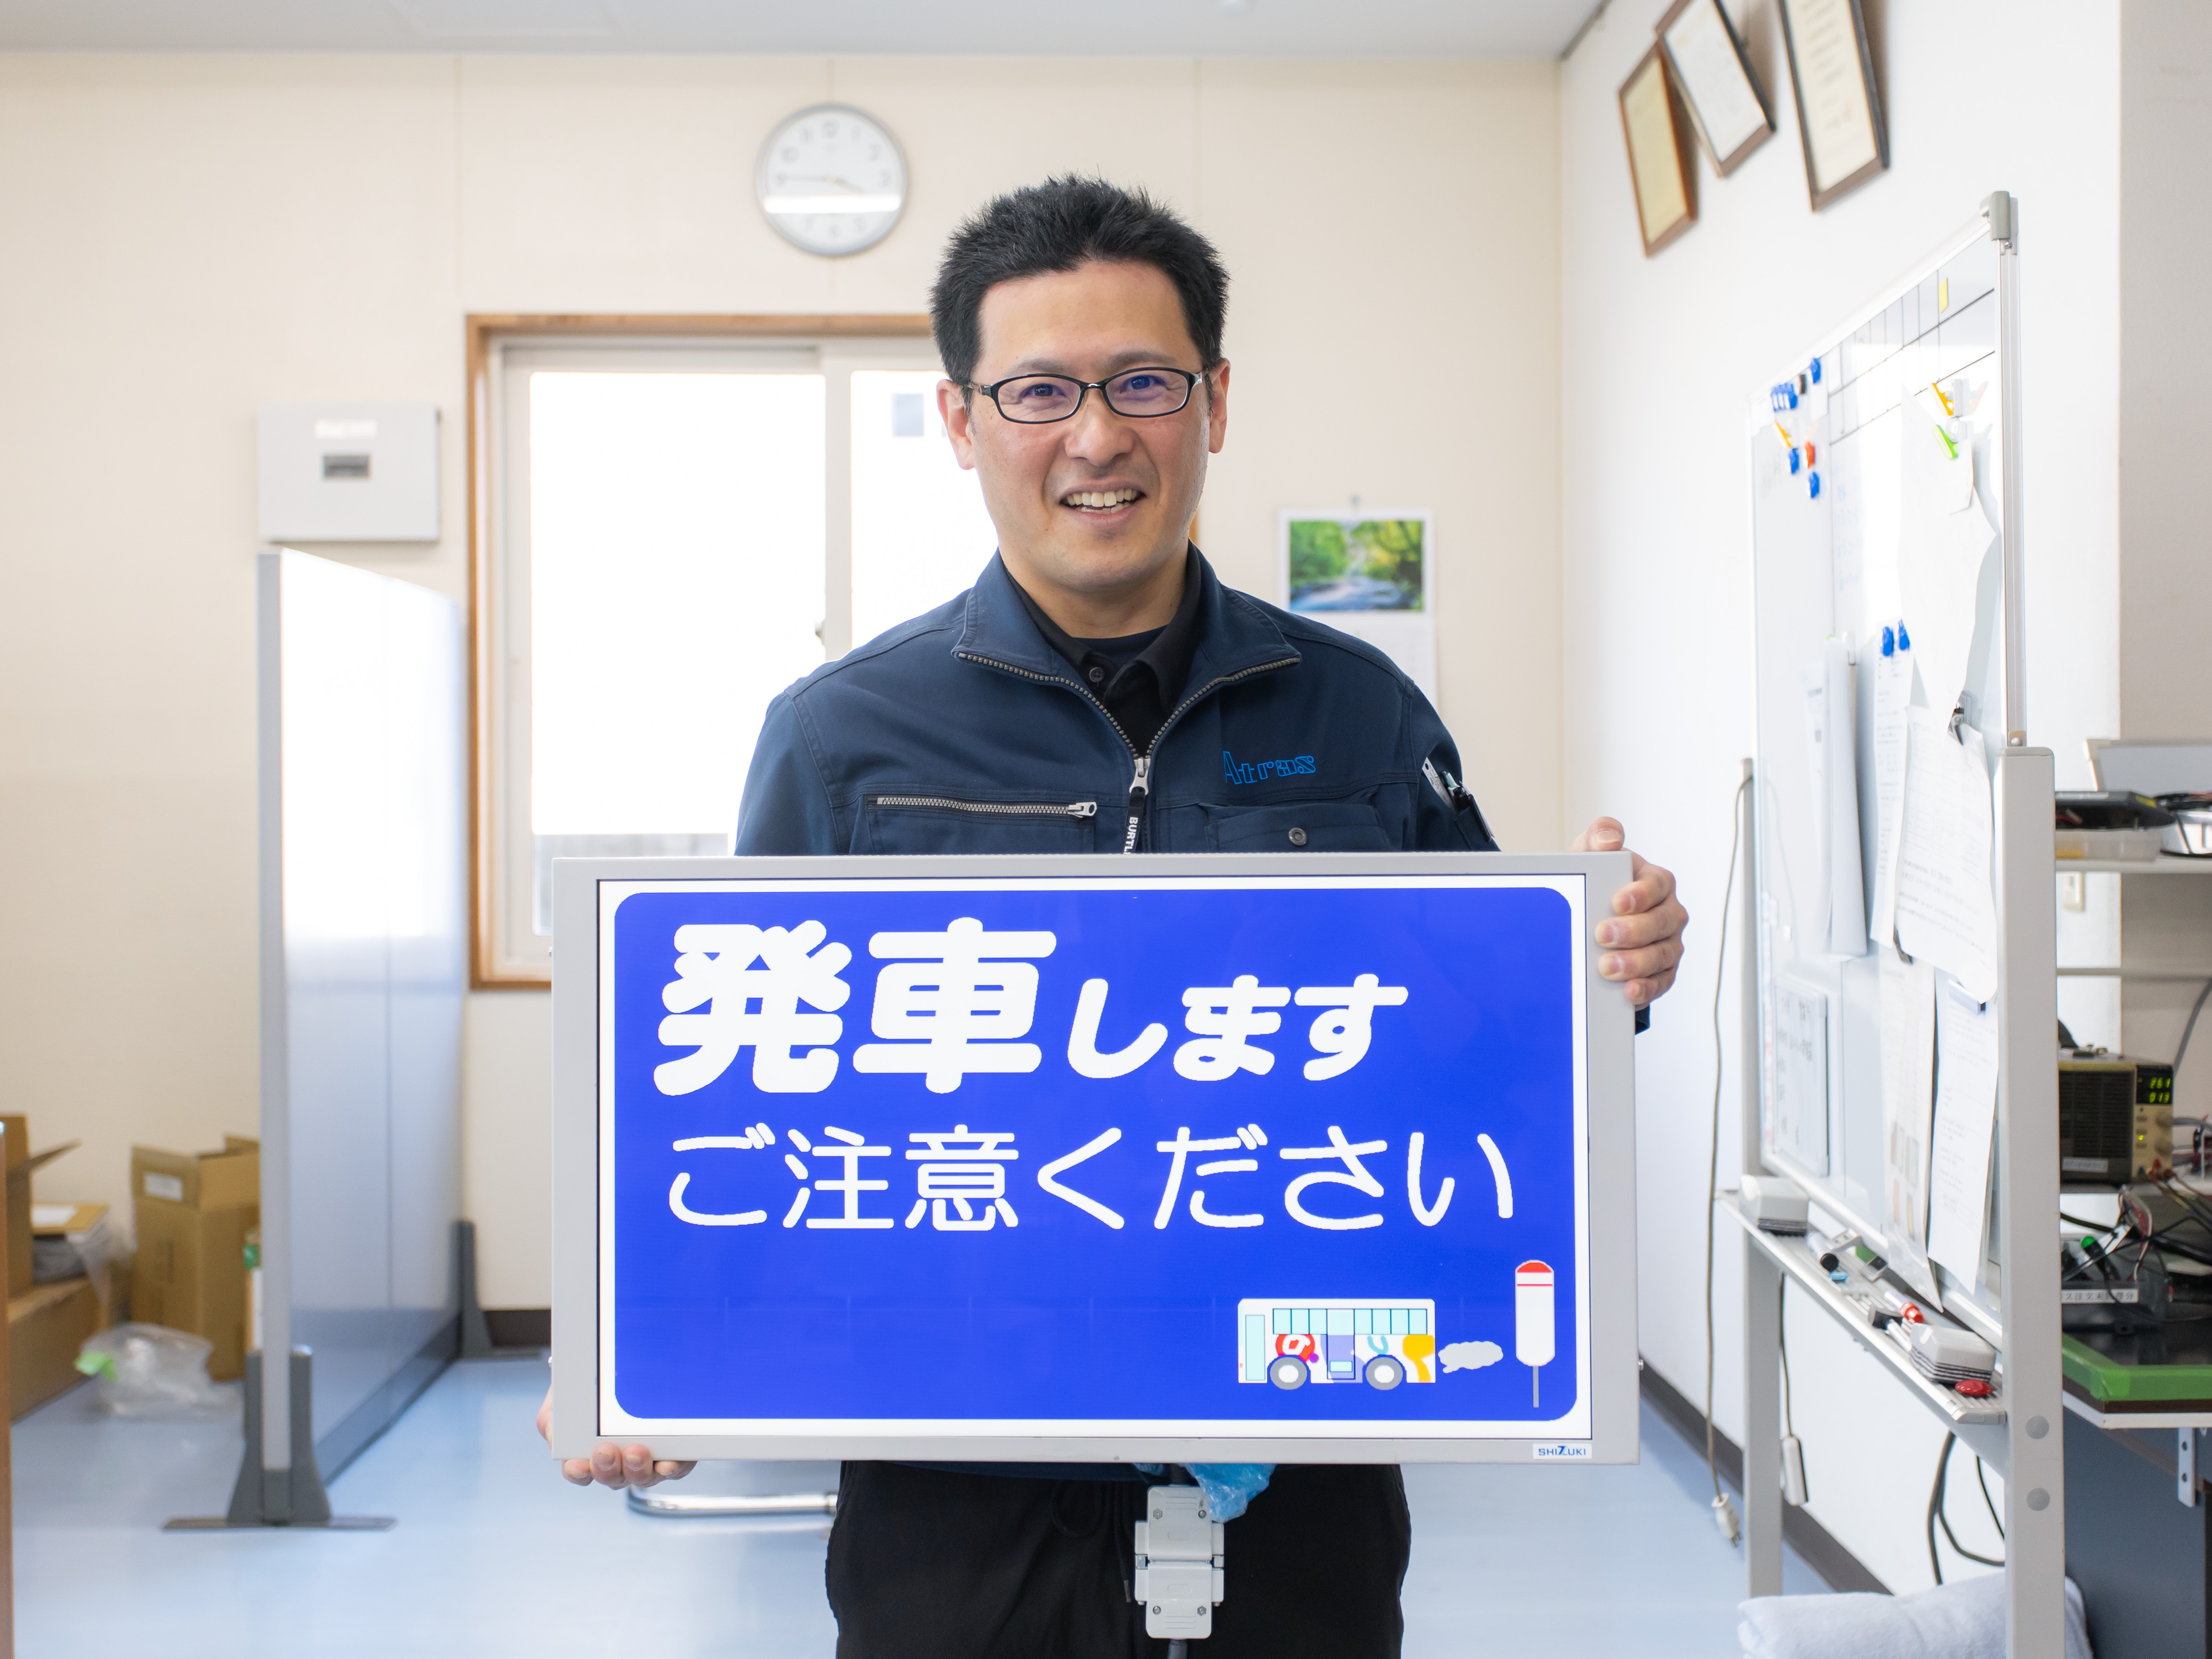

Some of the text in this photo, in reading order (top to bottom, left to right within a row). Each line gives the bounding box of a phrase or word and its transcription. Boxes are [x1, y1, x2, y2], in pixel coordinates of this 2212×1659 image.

[1222, 750, 1316, 785] Atras
[654, 917, 1408, 1096] 発車します
[669, 1123, 1513, 1231] ご注意ください
[1538, 1445, 1586, 1456] SHIZUKI
